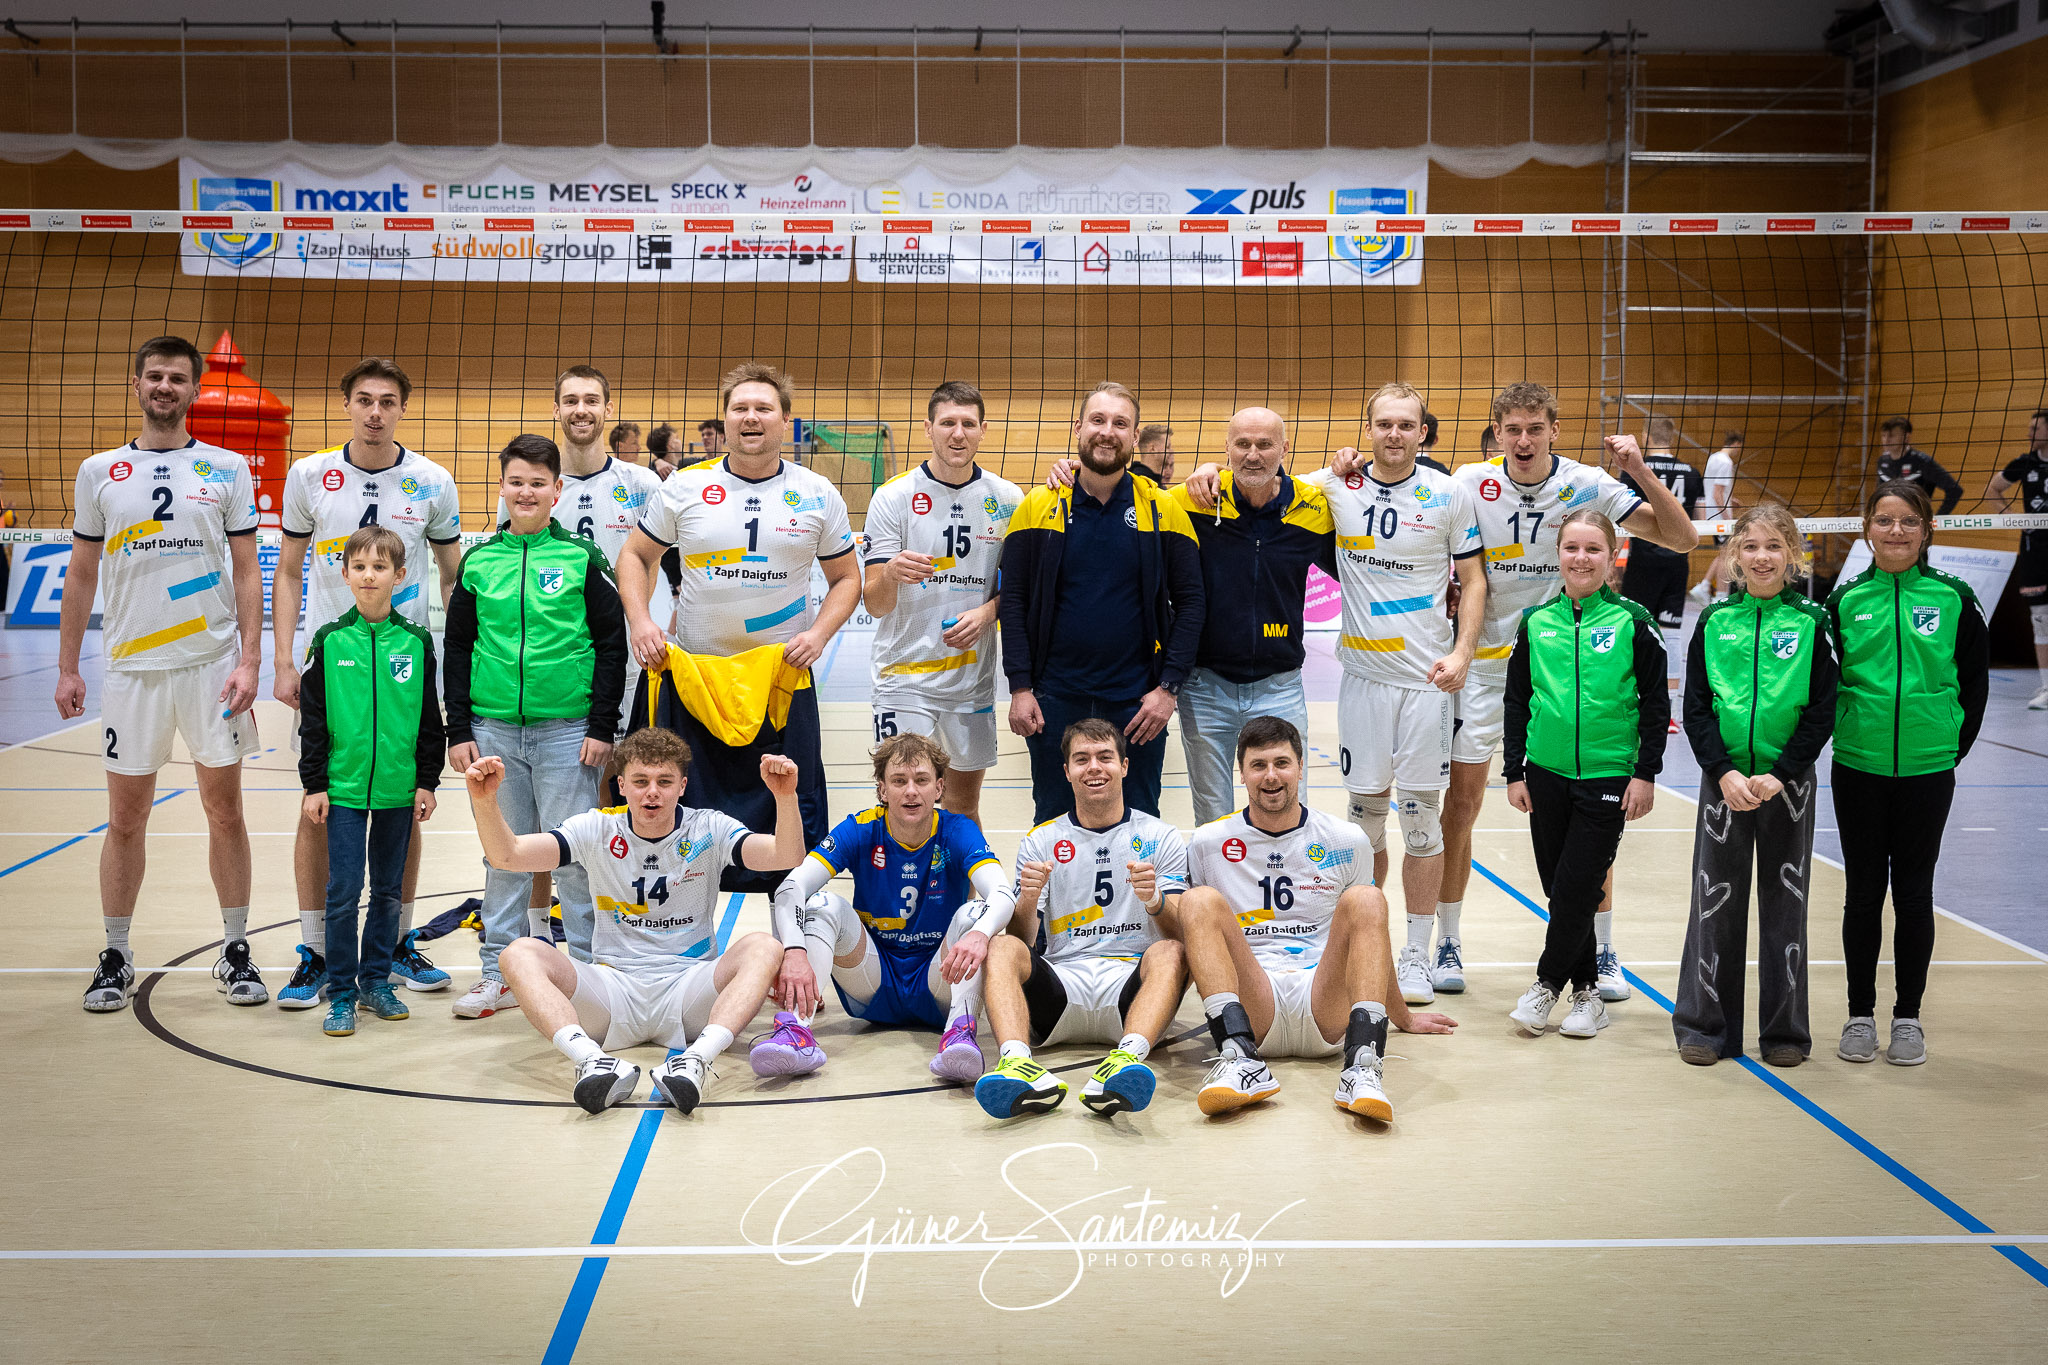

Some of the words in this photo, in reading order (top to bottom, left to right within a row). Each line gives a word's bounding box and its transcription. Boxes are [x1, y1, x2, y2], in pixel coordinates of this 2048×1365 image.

[296, 184, 408, 212] maxit
[449, 185, 535, 199] FUCHS
[550, 184, 659, 202] MEYSEL
[671, 184, 728, 199] SPECK
[1249, 181, 1306, 214] puls
[671, 202, 730, 214] pumpen
[760, 197, 847, 210] Heinzelmann
[919, 192, 1009, 209] LEONDA
[481, 204, 536, 213] umsetzen
[310, 244, 342, 258] Zapf
[348, 244, 411, 259] Daigfuss
[879, 265, 946, 275] SERVICES
[152, 486, 174, 521] 2
[358, 504, 379, 528] 4
[1363, 504, 1398, 540] 10
[1944, 518, 1992, 528] FUCHS
[2003, 517, 2030, 527] Ideen
[577, 516, 594, 539] 6
[744, 518, 759, 552] 1
[776, 526, 811, 534] Heinzelmann
[1507, 511, 1545, 544] 17
[0, 533, 43, 541] UCHS
[132, 539, 157, 551] Zapf
[159, 537, 204, 550] Daigfuss
[942, 524, 972, 559] 15
[1348, 550, 1368, 564] Zapf
[1369, 556, 1414, 571] Daigfuss
[1493, 562, 1518, 573] Zapf
[1519, 564, 1560, 574] Daigfus
[714, 566, 740, 579] Zapf
[742, 569, 788, 582] Daigfuss
[928, 573, 949, 584] Zapf
[857, 614, 873, 625] 60
[1854, 613, 1873, 622] JAKO
[1263, 623, 1289, 638] MM
[1718, 633, 1737, 641] JAKO
[337, 659, 355, 667] JAKO
[874, 711, 898, 743] 15
[106, 727, 119, 760] 2
[1601, 793, 1620, 803] JAKO
[632, 876, 670, 907] 14
[1094, 870, 1114, 908] 5
[1257, 876, 1295, 911] 16
[900, 885, 919, 920] 3
[645, 915, 694, 929] Daigfuss
[1073, 927, 1097, 939] Zapf
[1099, 923, 1142, 937] Daigfuss
[1244, 926, 1269, 936] Zapf
[1272, 924, 1318, 936] Daigfuss
